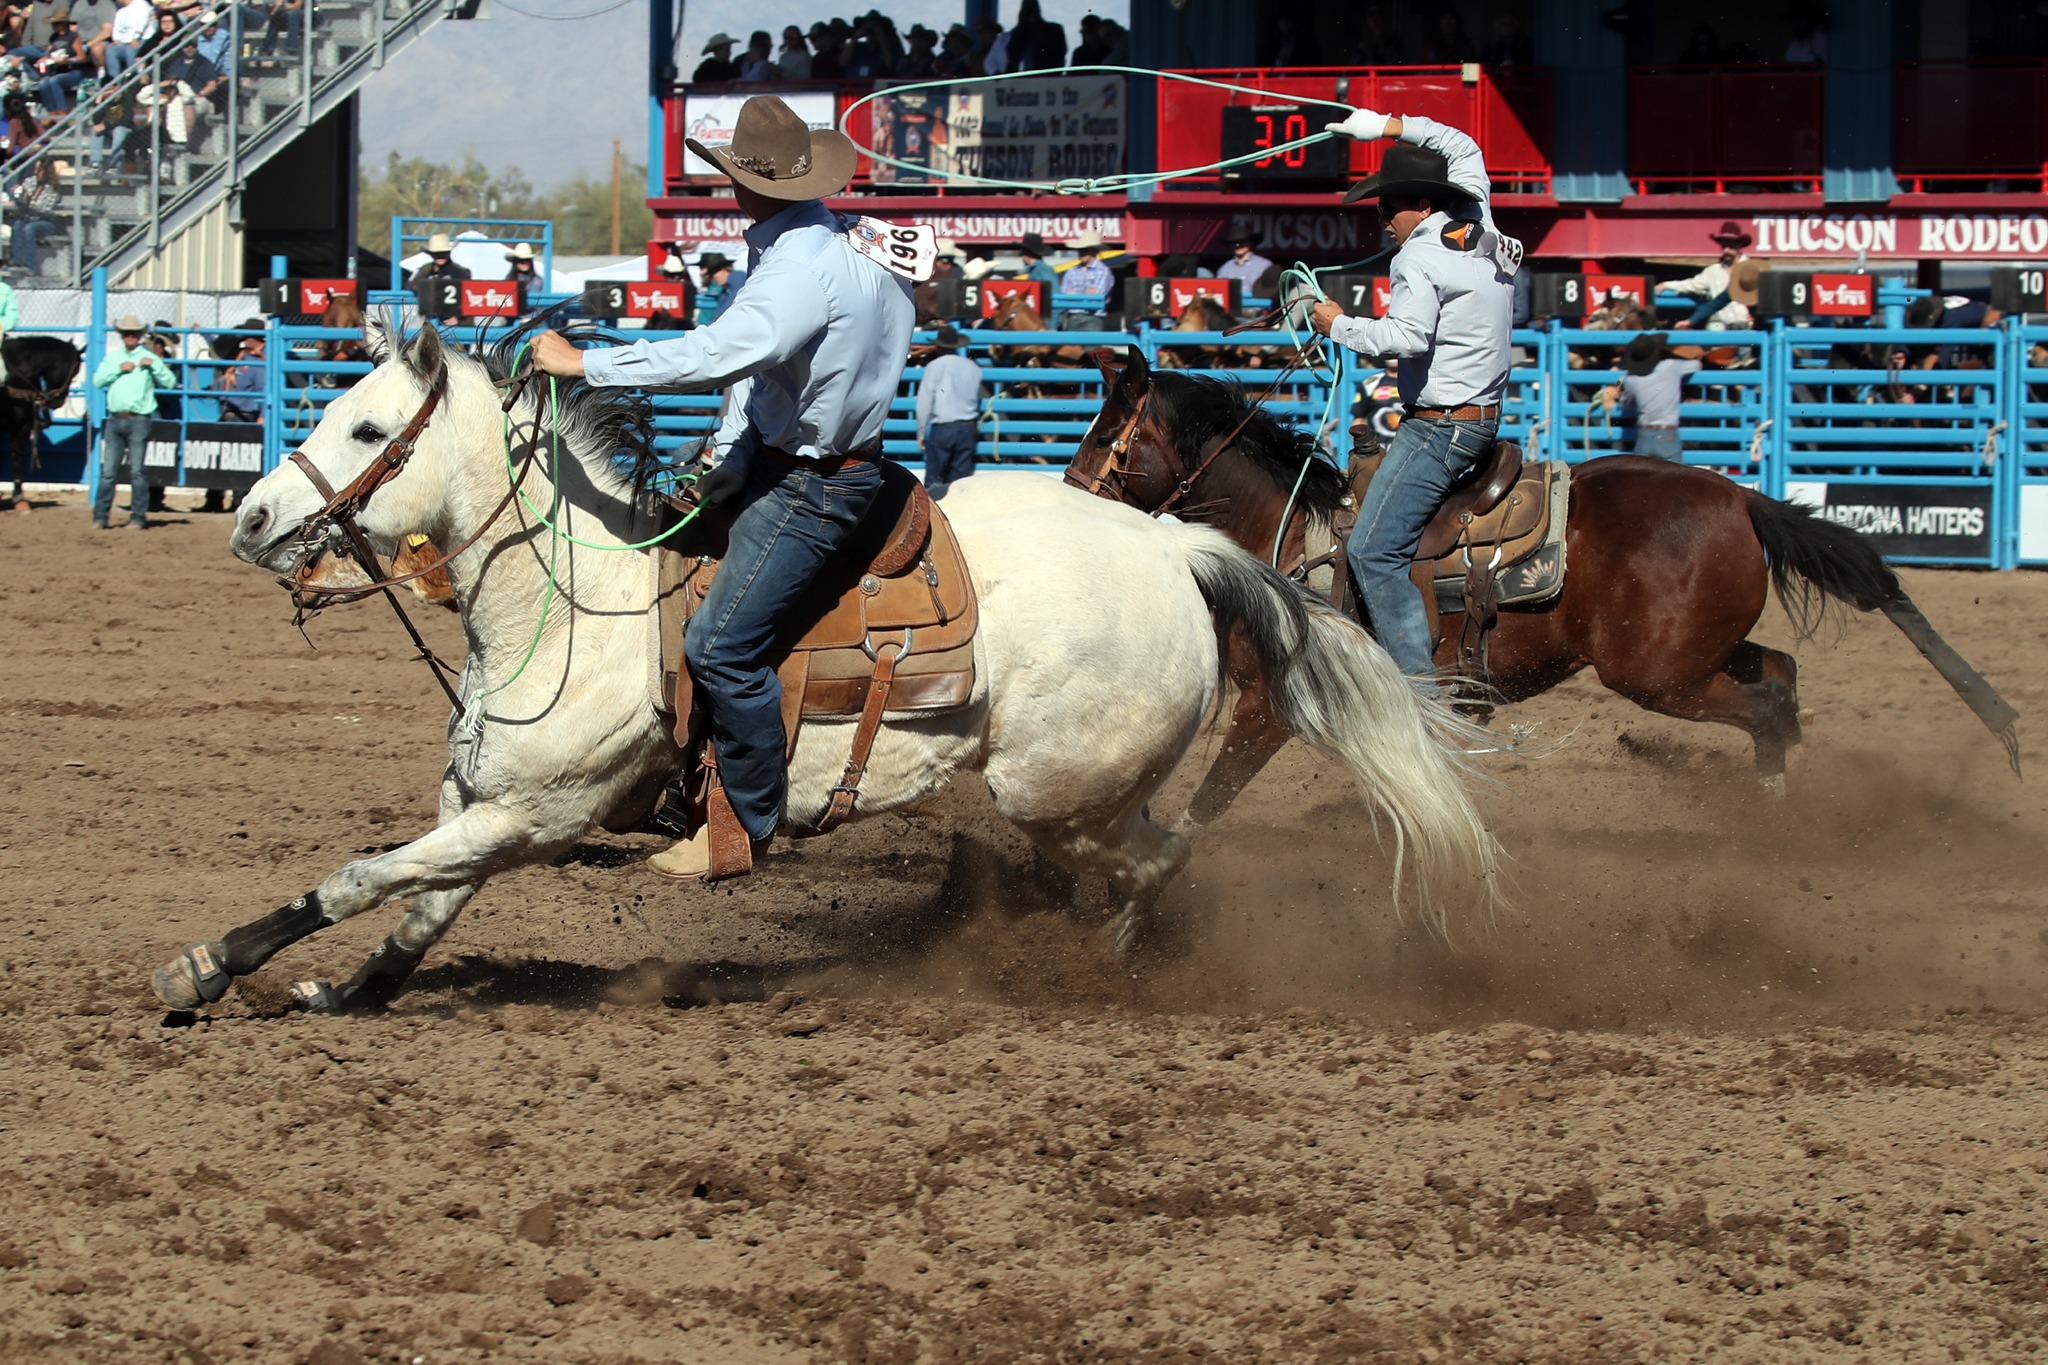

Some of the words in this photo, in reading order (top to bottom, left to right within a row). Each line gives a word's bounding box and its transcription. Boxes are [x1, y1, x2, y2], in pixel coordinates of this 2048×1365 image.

[955, 144, 1035, 178] TUCSON
[1048, 143, 1118, 178] RODEO
[1752, 215, 1897, 251] TUCSON
[1918, 214, 2048, 252] RODEO
[890, 229, 919, 275] 196
[278, 284, 289, 303] 1
[444, 285, 457, 304] 2
[1151, 283, 1164, 305] 6
[1565, 279, 1578, 302] 8
[1792, 282, 1806, 305] 9
[2018, 271, 2044, 295] 10
[610, 288, 622, 308] 3
[965, 286, 978, 306] 5
[1352, 285, 1366, 306] 7
[143, 440, 178, 468] ARN
[184, 440, 220, 470] BOOT
[220, 442, 263, 472] BARN
[1907, 506, 1985, 537] HATTERS
